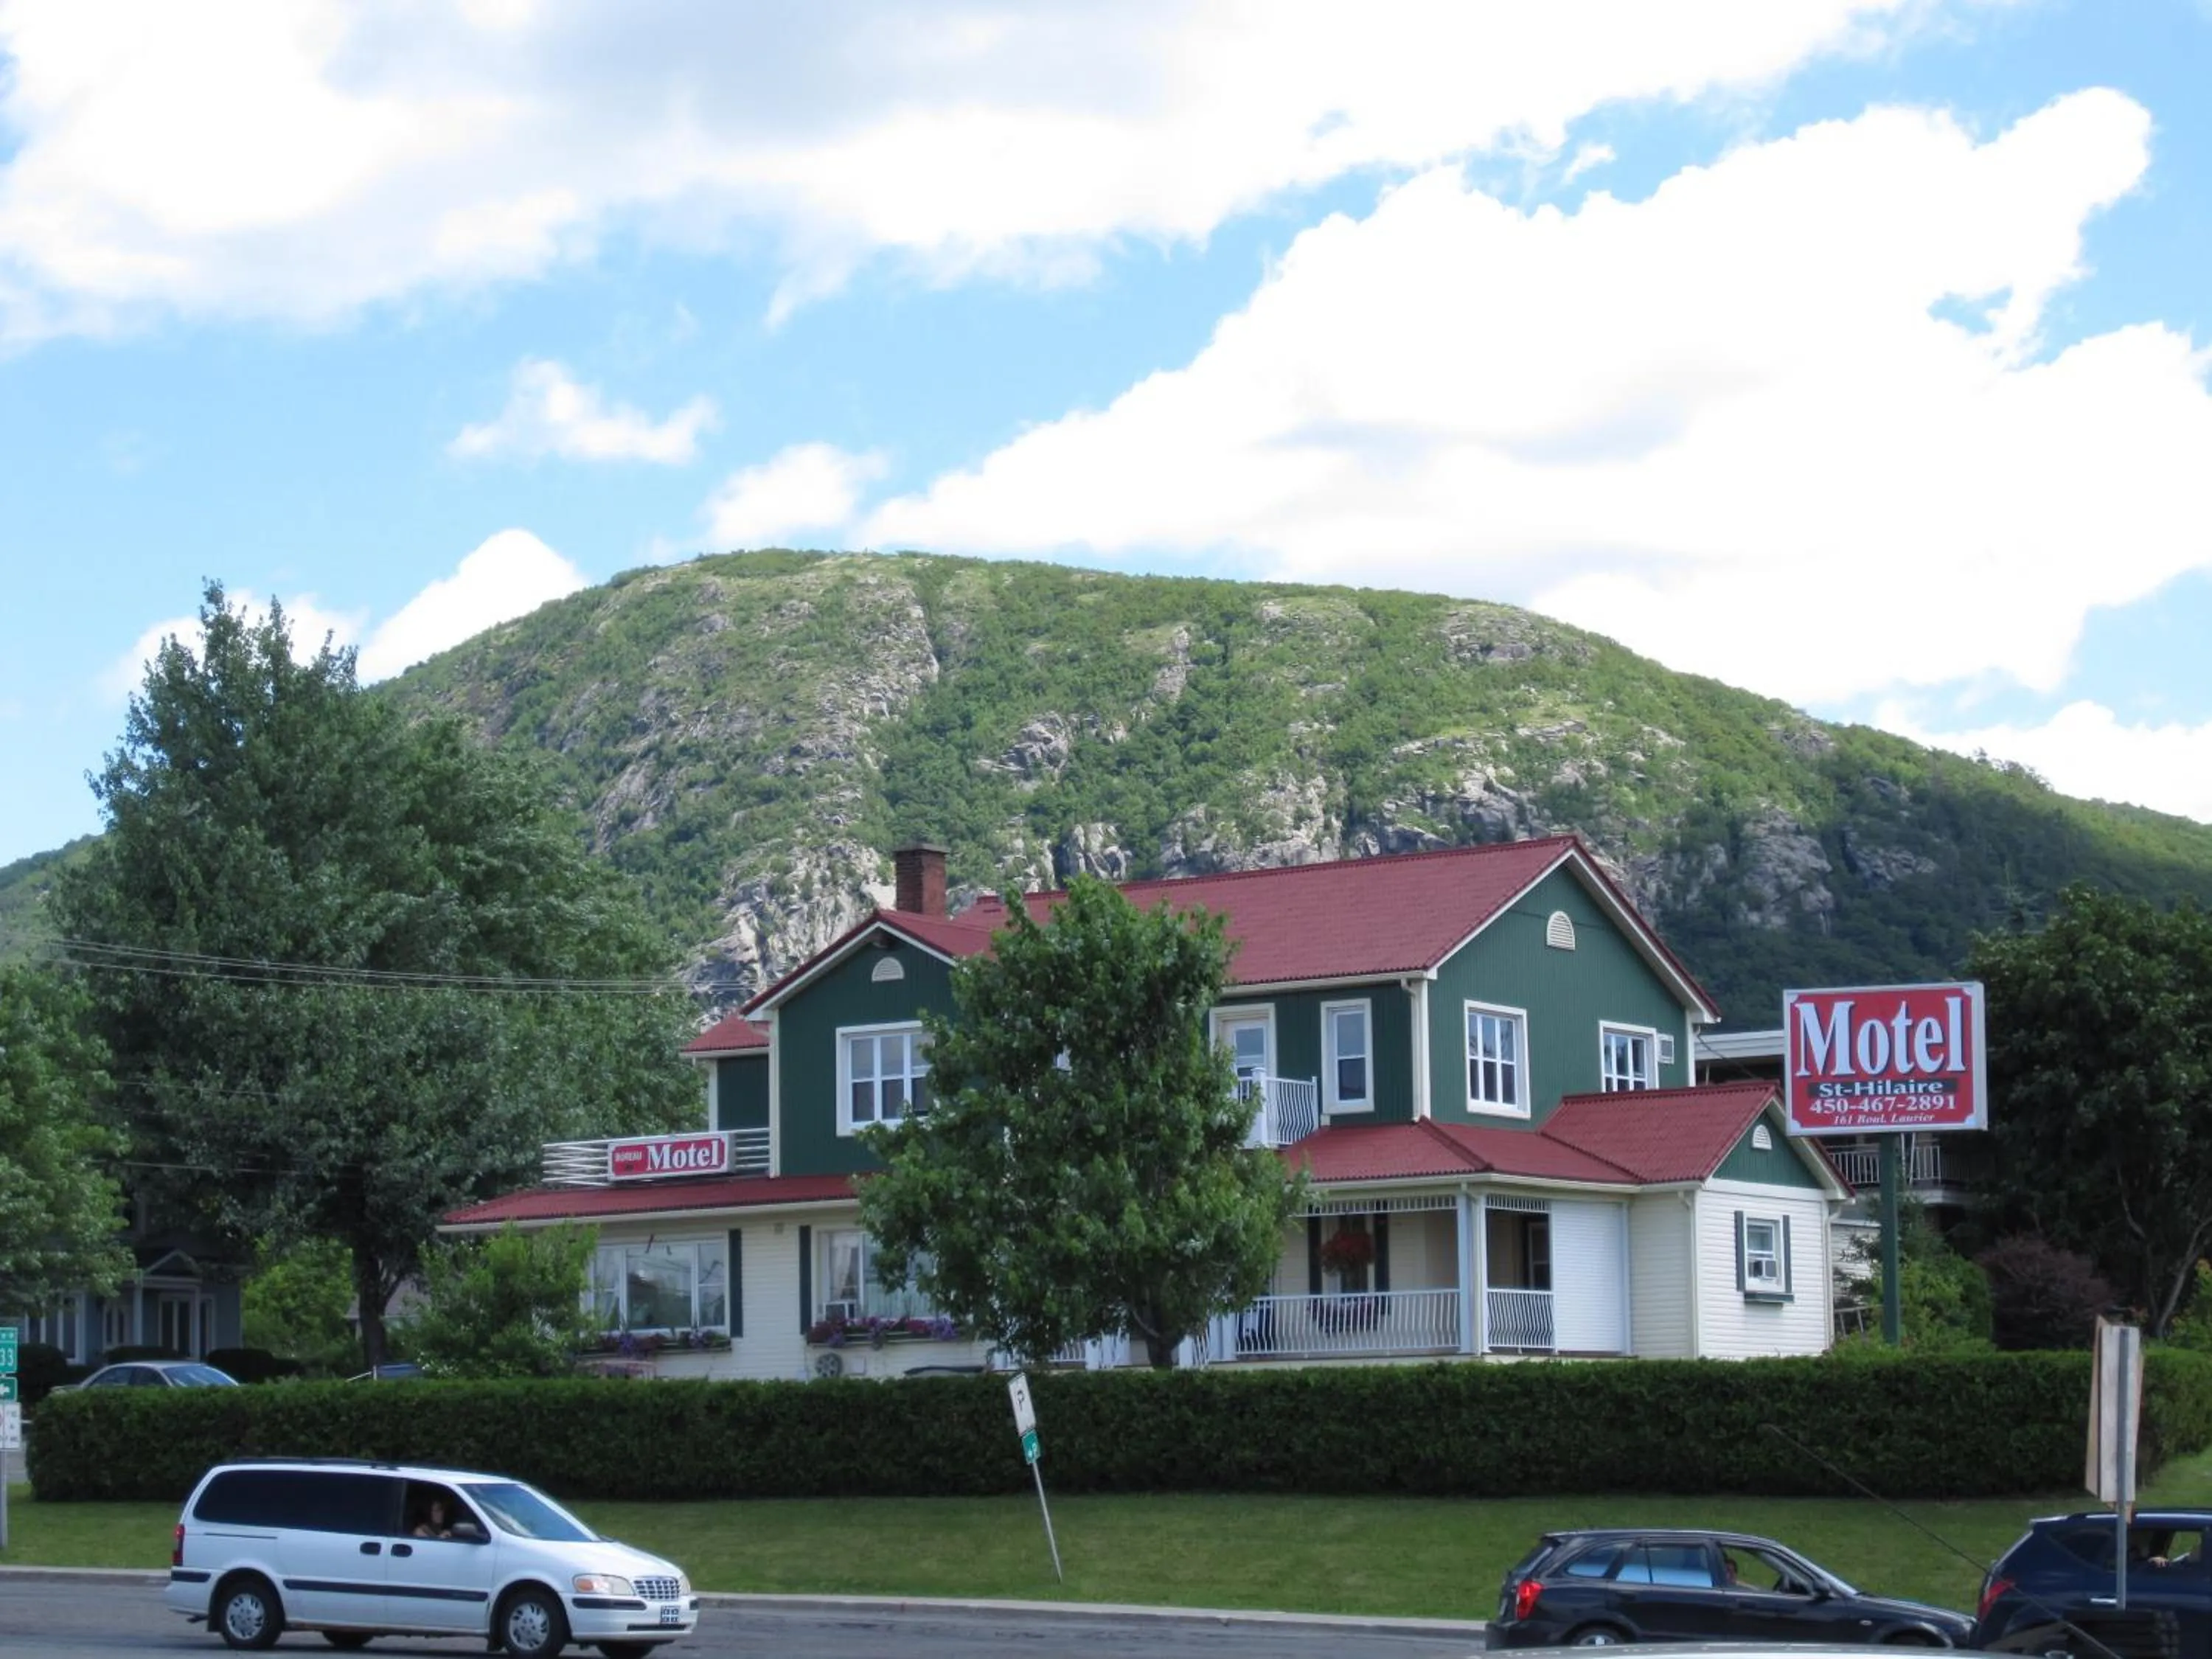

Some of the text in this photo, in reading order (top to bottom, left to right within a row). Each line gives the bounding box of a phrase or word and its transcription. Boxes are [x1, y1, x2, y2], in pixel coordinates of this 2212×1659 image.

[1795, 997, 1966, 1076] Motel
[1819, 1079, 1943, 1098] St-Hilaire
[1809, 1095, 1955, 1114] 450-467-2891
[1834, 1115, 1853, 1125] 161
[1891, 1113, 1935, 1123] Laurier
[646, 1140, 720, 1171] Motel
